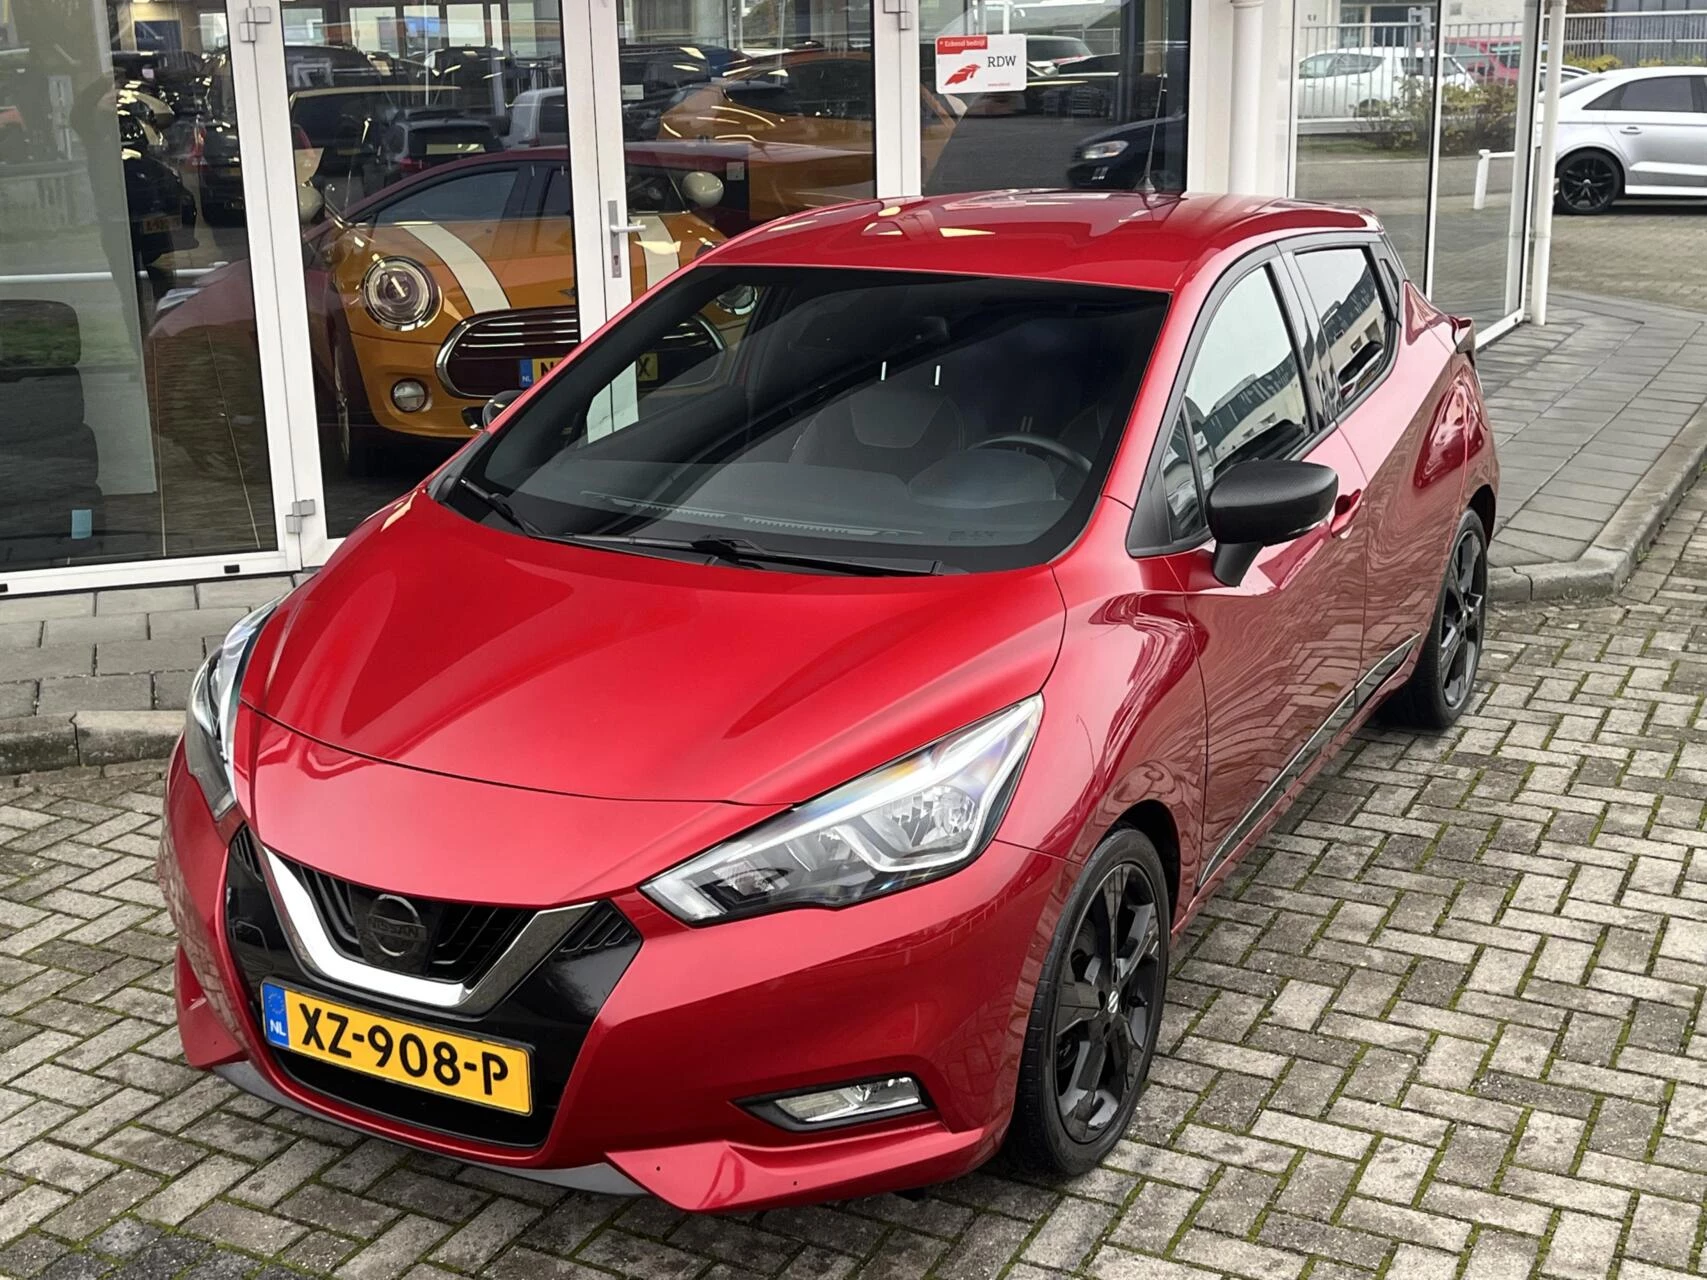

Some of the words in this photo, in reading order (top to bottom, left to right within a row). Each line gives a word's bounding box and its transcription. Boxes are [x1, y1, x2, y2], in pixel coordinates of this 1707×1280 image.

[987, 55, 1016, 67] RDW
[269, 1019, 287, 1036] NL
[299, 1003, 509, 1095] XZ-908-P
